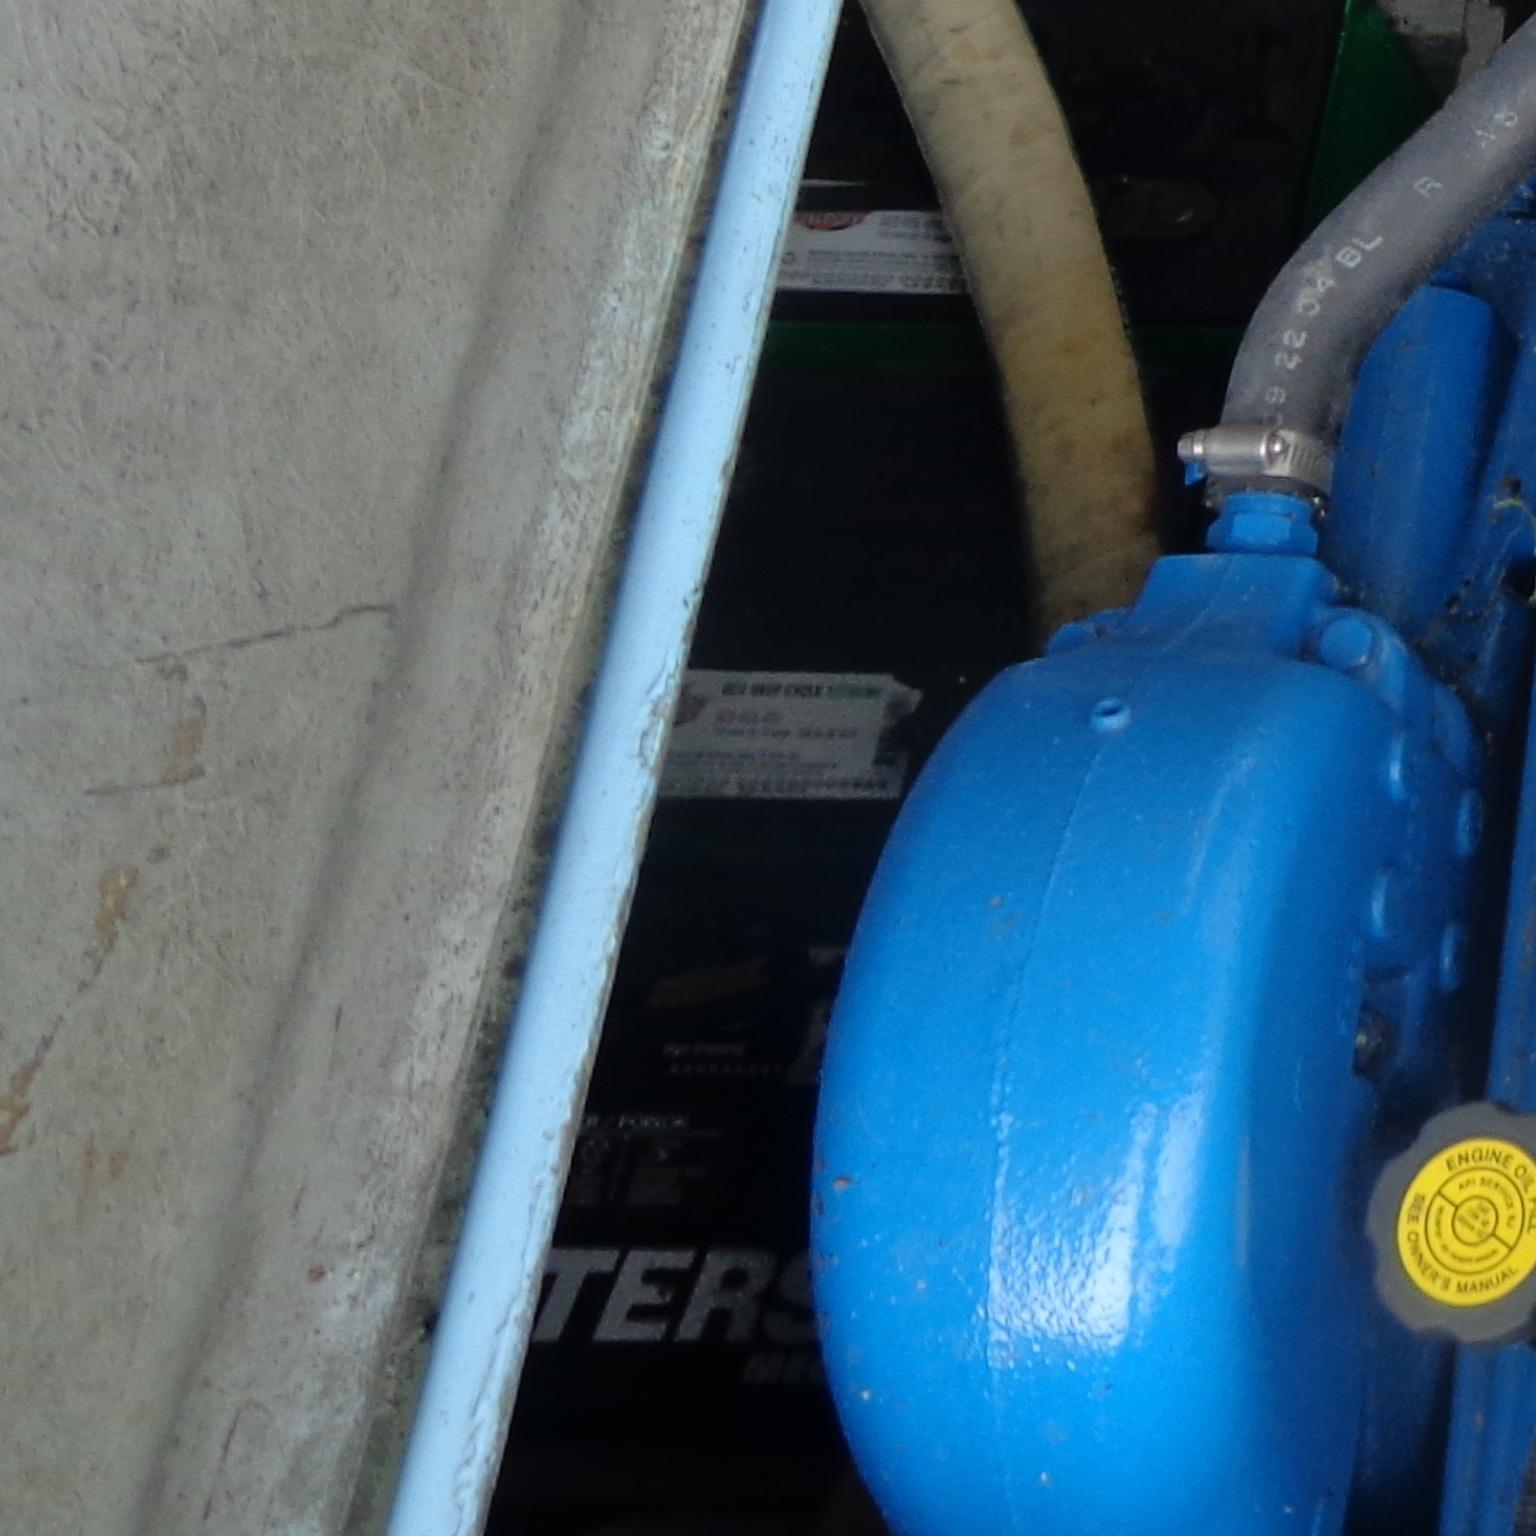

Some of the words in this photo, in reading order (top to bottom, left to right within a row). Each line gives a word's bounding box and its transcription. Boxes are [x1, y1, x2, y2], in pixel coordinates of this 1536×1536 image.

[1275, 328, 1308, 371] 22
[1337, 233, 1383, 268] BL
[1446, 1147, 1514, 1171] ENGINE
[1514, 1165, 1535, 1194] OIL
[1407, 1192, 1425, 1224] SEE
[1408, 1231, 1451, 1293] OWNER'S
[1456, 1266, 1519, 1294] MANUAL
